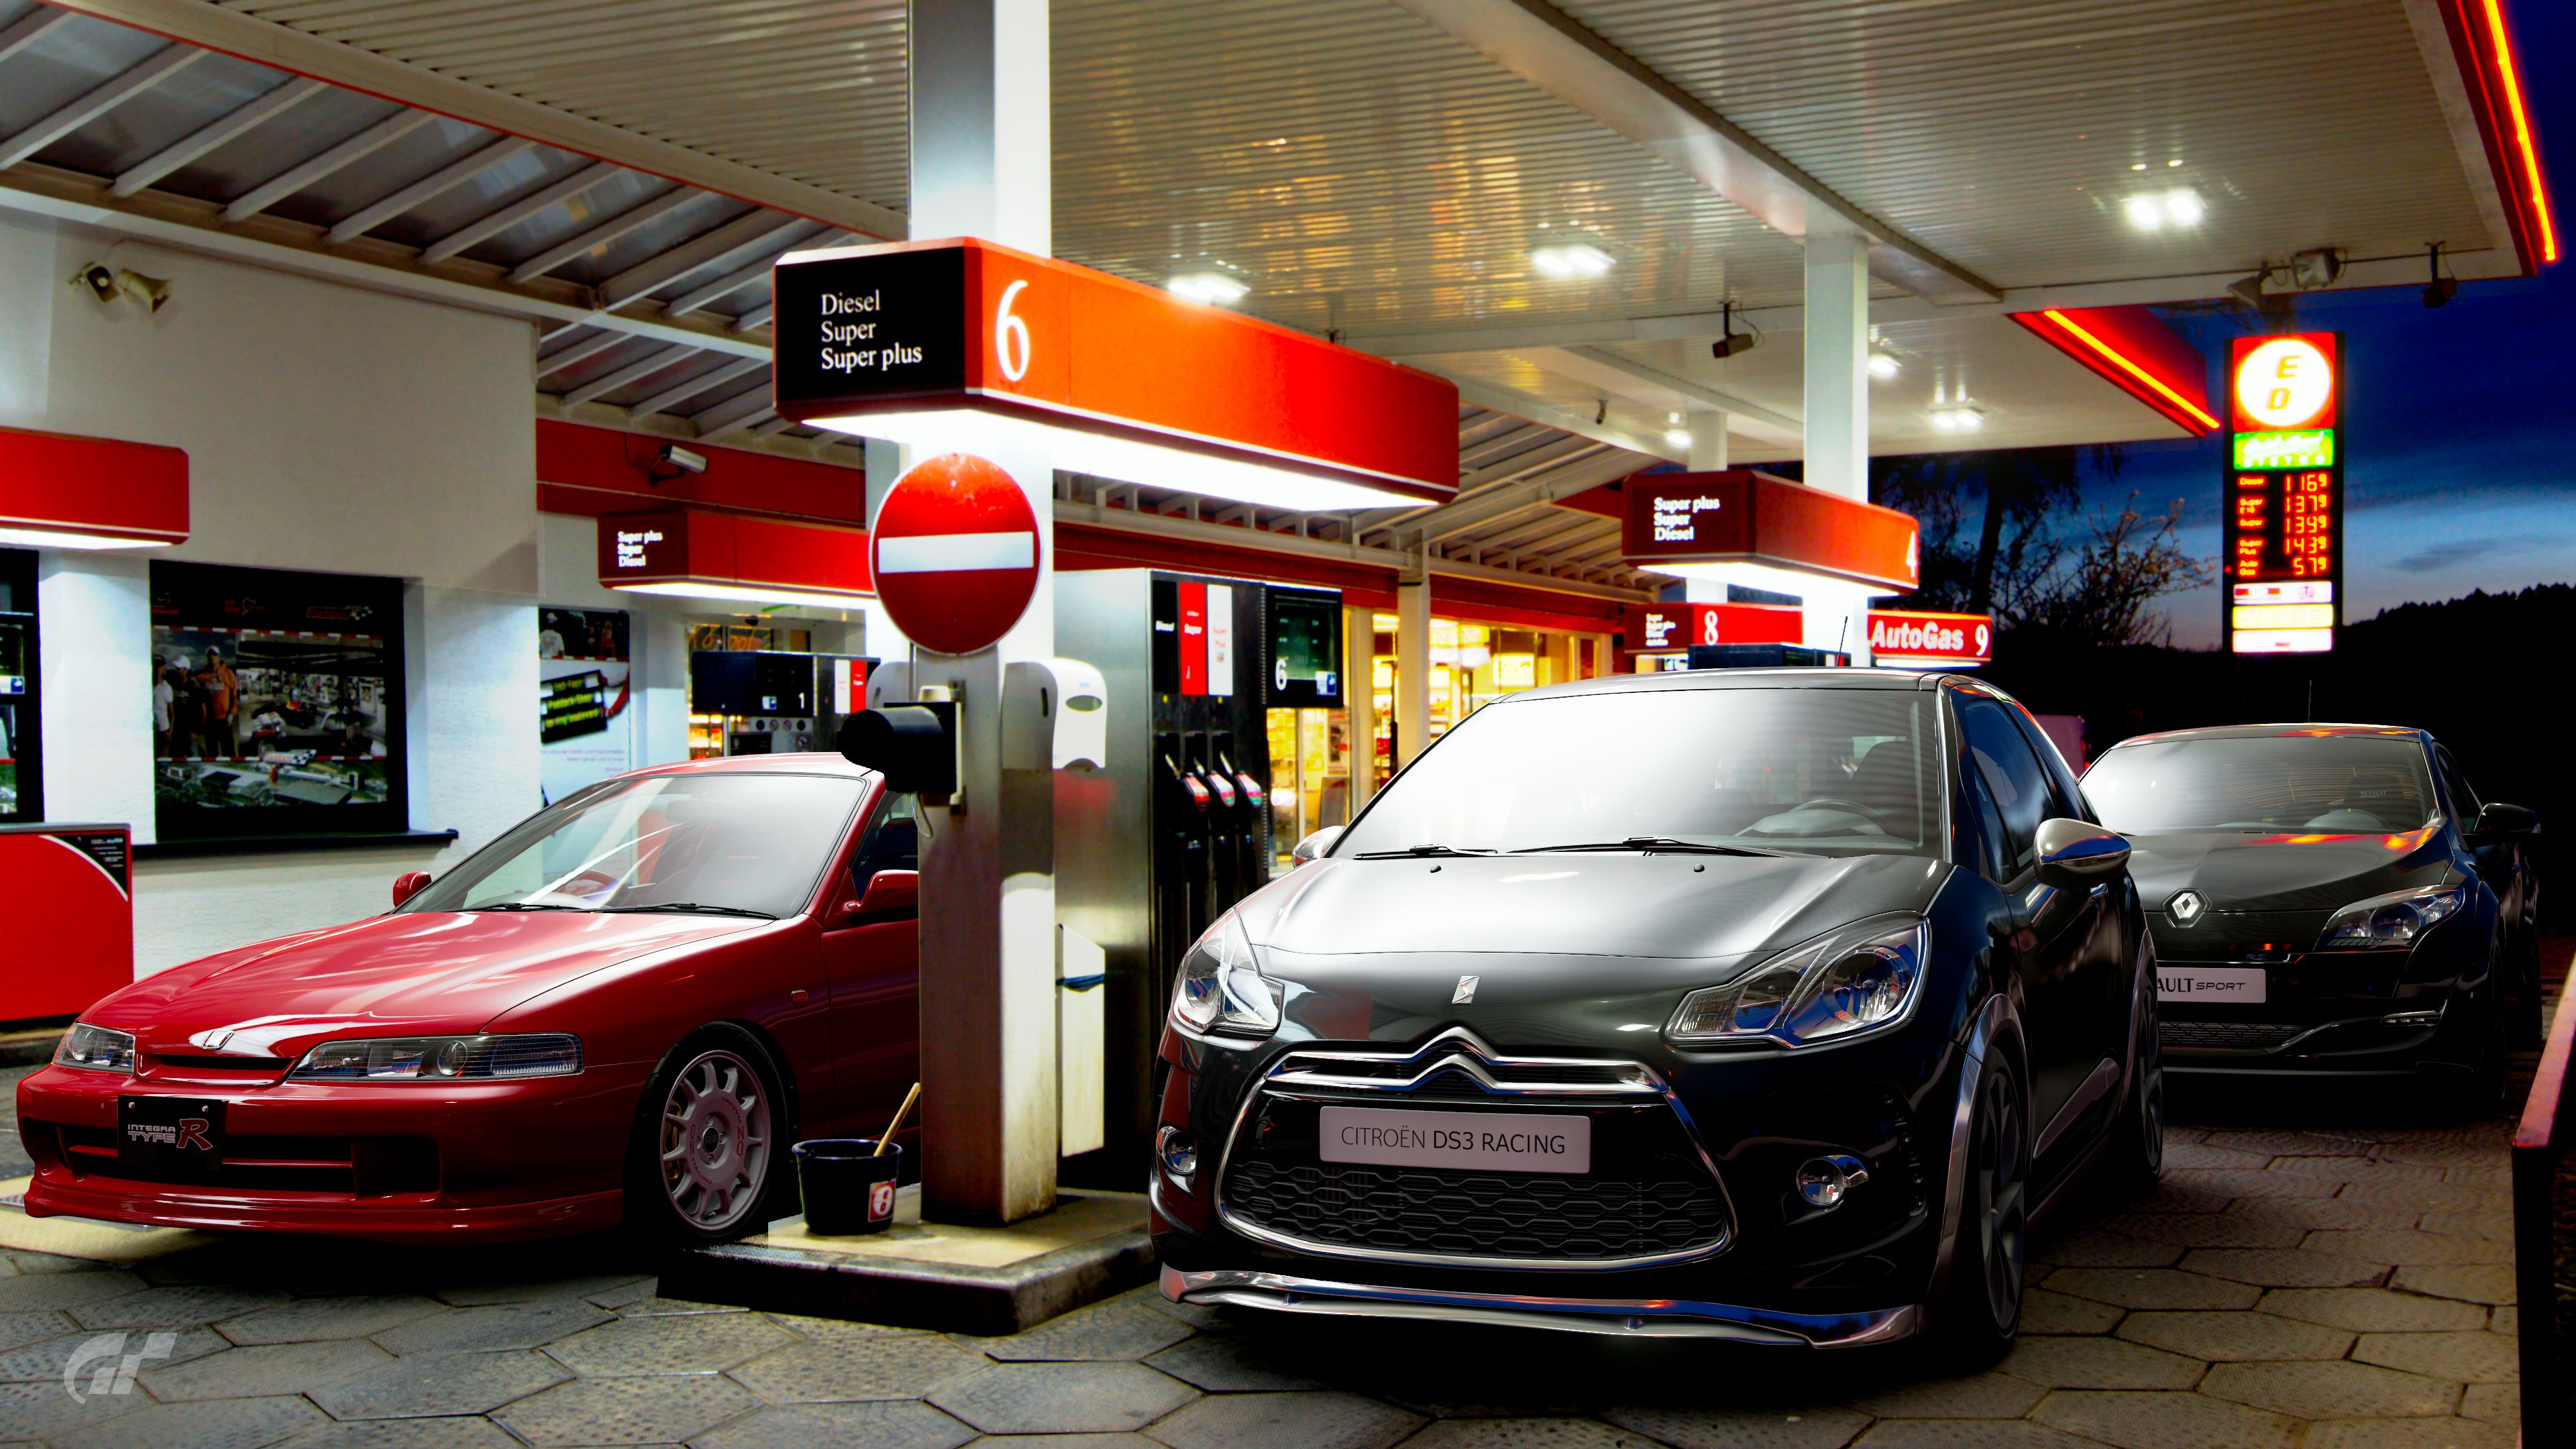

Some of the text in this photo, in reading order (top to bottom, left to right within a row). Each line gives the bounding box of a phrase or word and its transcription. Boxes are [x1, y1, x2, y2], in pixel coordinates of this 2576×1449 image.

[820, 289, 881, 316] Diesel
[820, 320, 876, 346] Super
[996, 280, 1030, 382] 6
[820, 343, 923, 374] Super plus
[1654, 495, 1721, 515] Super plus
[1654, 512, 1692, 529] Super
[1654, 526, 1695, 541] Diesel
[1705, 610, 1719, 646] 8
[1872, 620, 1990, 657] AutoGas 9
[1275, 659, 1287, 690] 6
[2157, 977, 2246, 993] AULT SPORT
[127, 1124, 176, 1133] INTEGRA
[127, 1118, 213, 1150] TYPE R
[1341, 1125, 1566, 1155] CITROËN DS3 RACING
